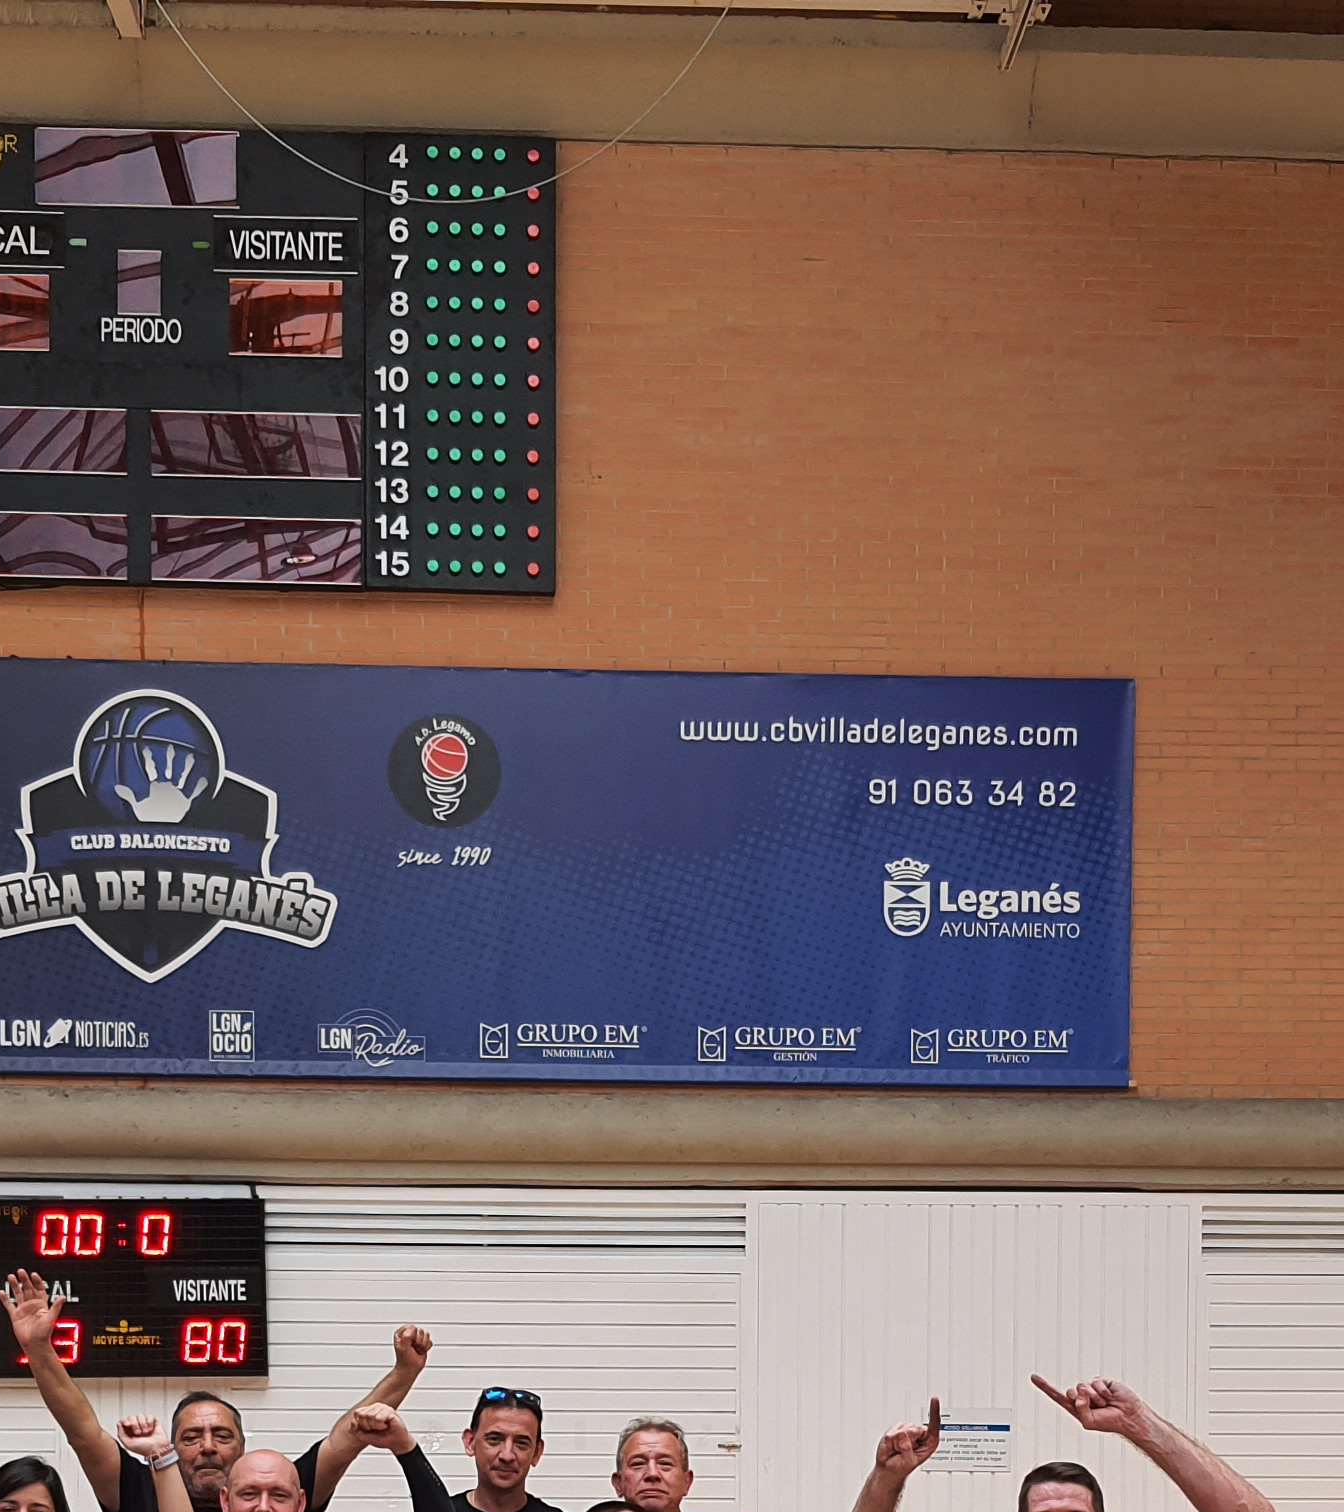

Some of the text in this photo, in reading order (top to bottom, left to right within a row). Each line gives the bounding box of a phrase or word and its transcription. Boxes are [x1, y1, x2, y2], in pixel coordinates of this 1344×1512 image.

[389, 144, 408, 168] 4
[389, 181, 409, 205] 5
[390, 217, 408, 242] 6
[230, 230, 343, 260] VISITANTE
[391, 255, 408, 279] 7
[390, 292, 408, 316] 8
[102, 315, 181, 343] PERIODO
[390, 329, 408, 354] 9
[375, 366, 408, 392] 10
[375, 404, 404, 429] 11
[375, 440, 408, 466] 12
[375, 478, 408, 503] 13
[375, 514, 409, 539] 14
[376, 551, 409, 576] 15
[681, 716, 1077, 750] www.cbvilladeleganes.com
[869, 779, 1075, 806] 91 063 34 82
[70, 834, 230, 854] CLUB BALONCESTO
[396, 846, 492, 868] since 1990
[98, 870, 146, 912] DE
[157, 870, 328, 938] LEGANÉS
[940, 881, 1080, 919] Leganés
[940, 922, 1079, 938] AYUNTAMIENTO
[0, 1019, 41, 1047] LGN
[213, 1013, 242, 1032] LGN
[517, 1023, 640, 1044] GRUPO EM
[213, 1033, 252, 1053] OCIO
[320, 1028, 424, 1067] LGN Radio
[735, 1027, 856, 1047] GRUPO EM
[947, 1028, 1068, 1049] GRUPO EM
[543, 1048, 615, 1059] INMOBILIARIA
[773, 1051, 817, 1063] GESTIÓN
[986, 1053, 1030, 1064] TRÁFICO
[5, 1280, 79, 1303] LAL
[173, 1279, 247, 1302] VISITANTE
[184, 1321, 247, 1363] 80
